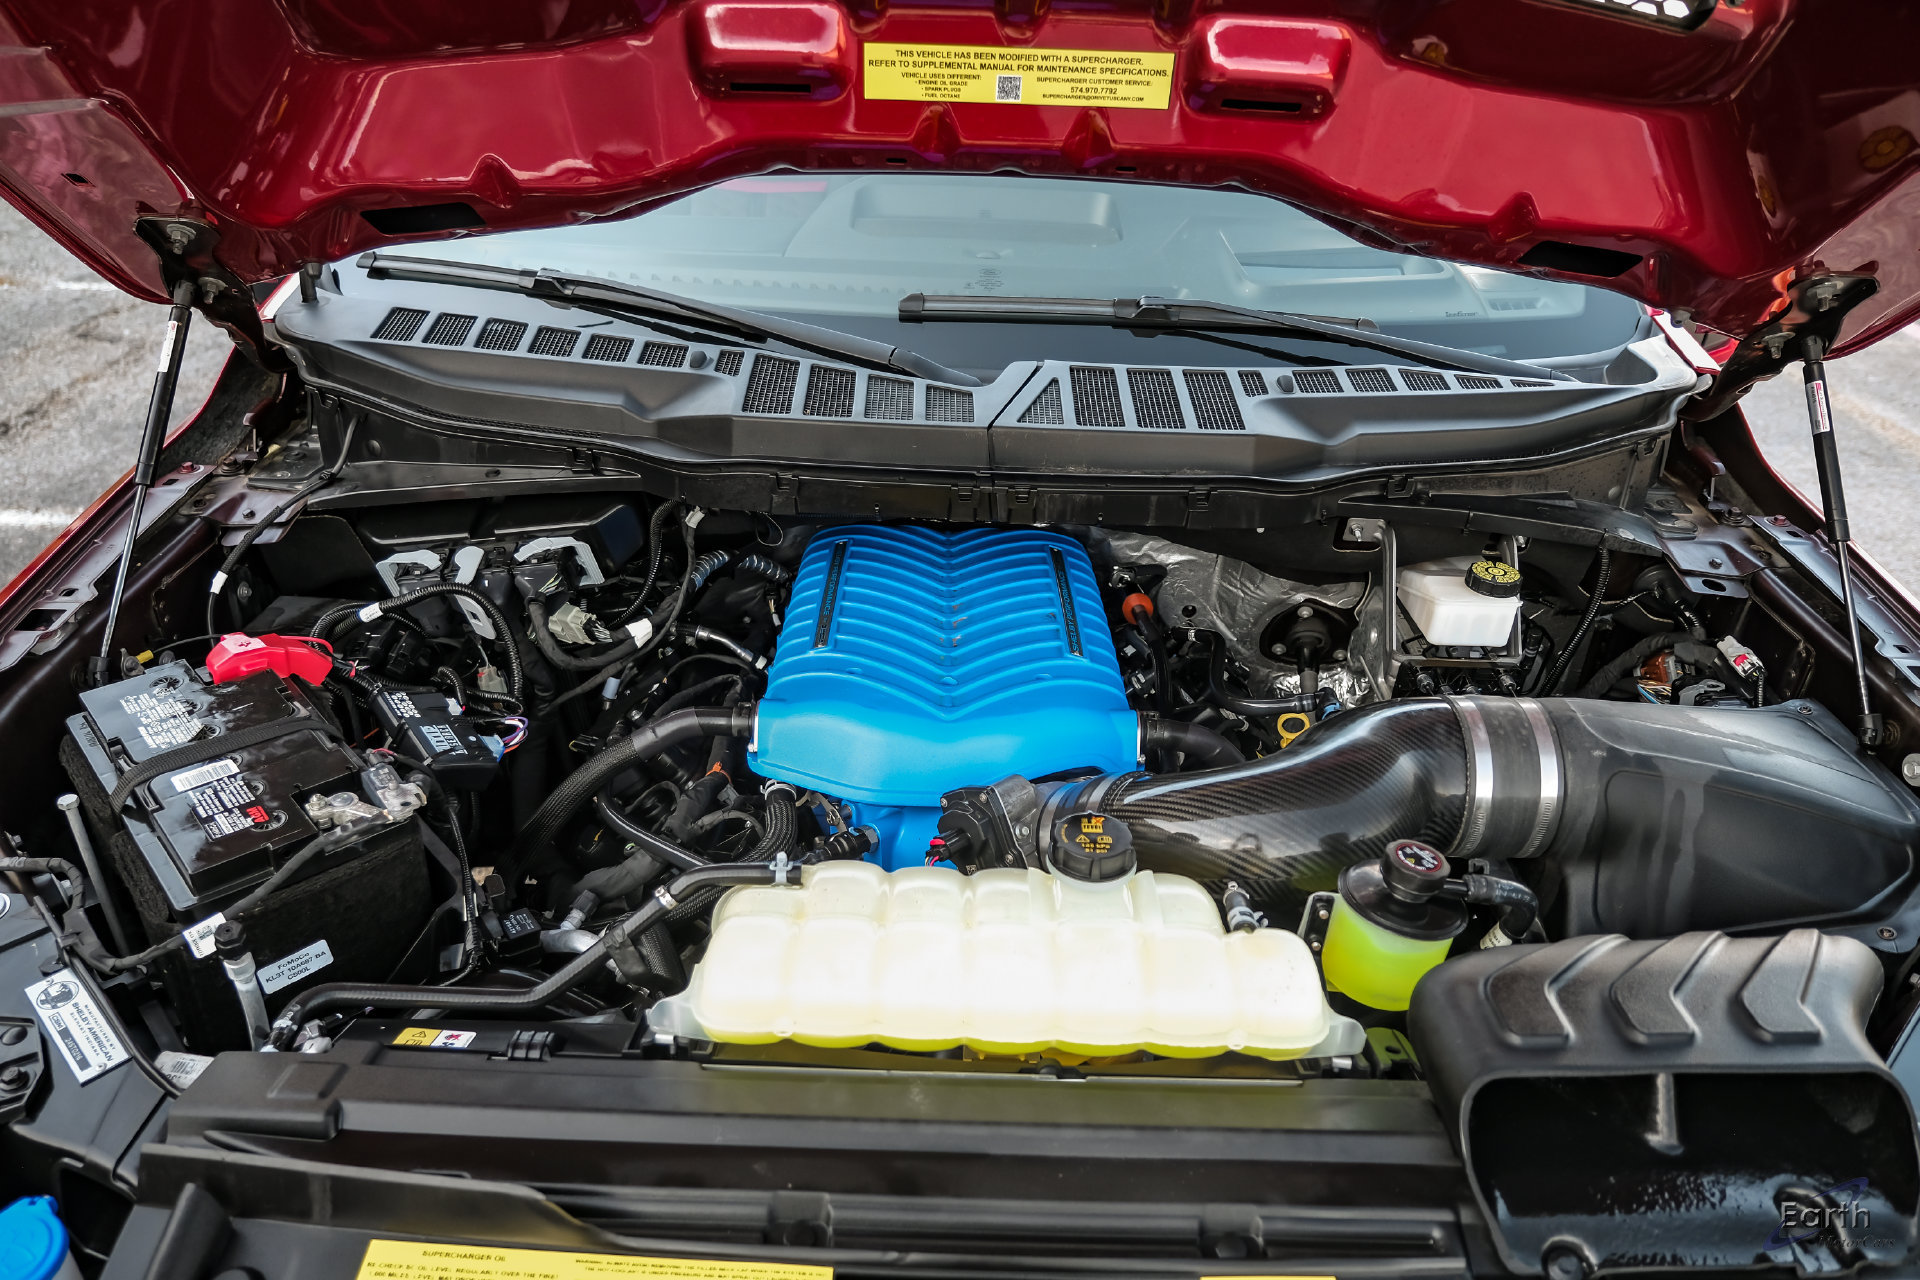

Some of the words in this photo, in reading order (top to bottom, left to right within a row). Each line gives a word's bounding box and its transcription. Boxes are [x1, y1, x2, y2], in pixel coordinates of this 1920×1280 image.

[916, 50, 952, 58] VEHICLE
[974, 52, 996, 60] BEEN
[998, 54, 1038, 62] MODIFIED
[1072, 56, 1144, 65] SUPERCHARGER.
[868, 60, 896, 68] REFER
[898, 60, 910, 68] TO
[912, 61, 978, 70] SUPPLEMENTAL
[980, 63, 1014, 71] MANUAL
[1017, 64, 1034, 72] FOR
[1036, 66, 1097, 74] MAINTENANCE
[1100, 67, 1169, 76] SPECIFICATIONS.
[1036, 76, 1088, 84] SUPERCHARGER
[72, 1002, 90, 1026] SHELBY
[88, 1026, 114, 1062] AMERICAN
